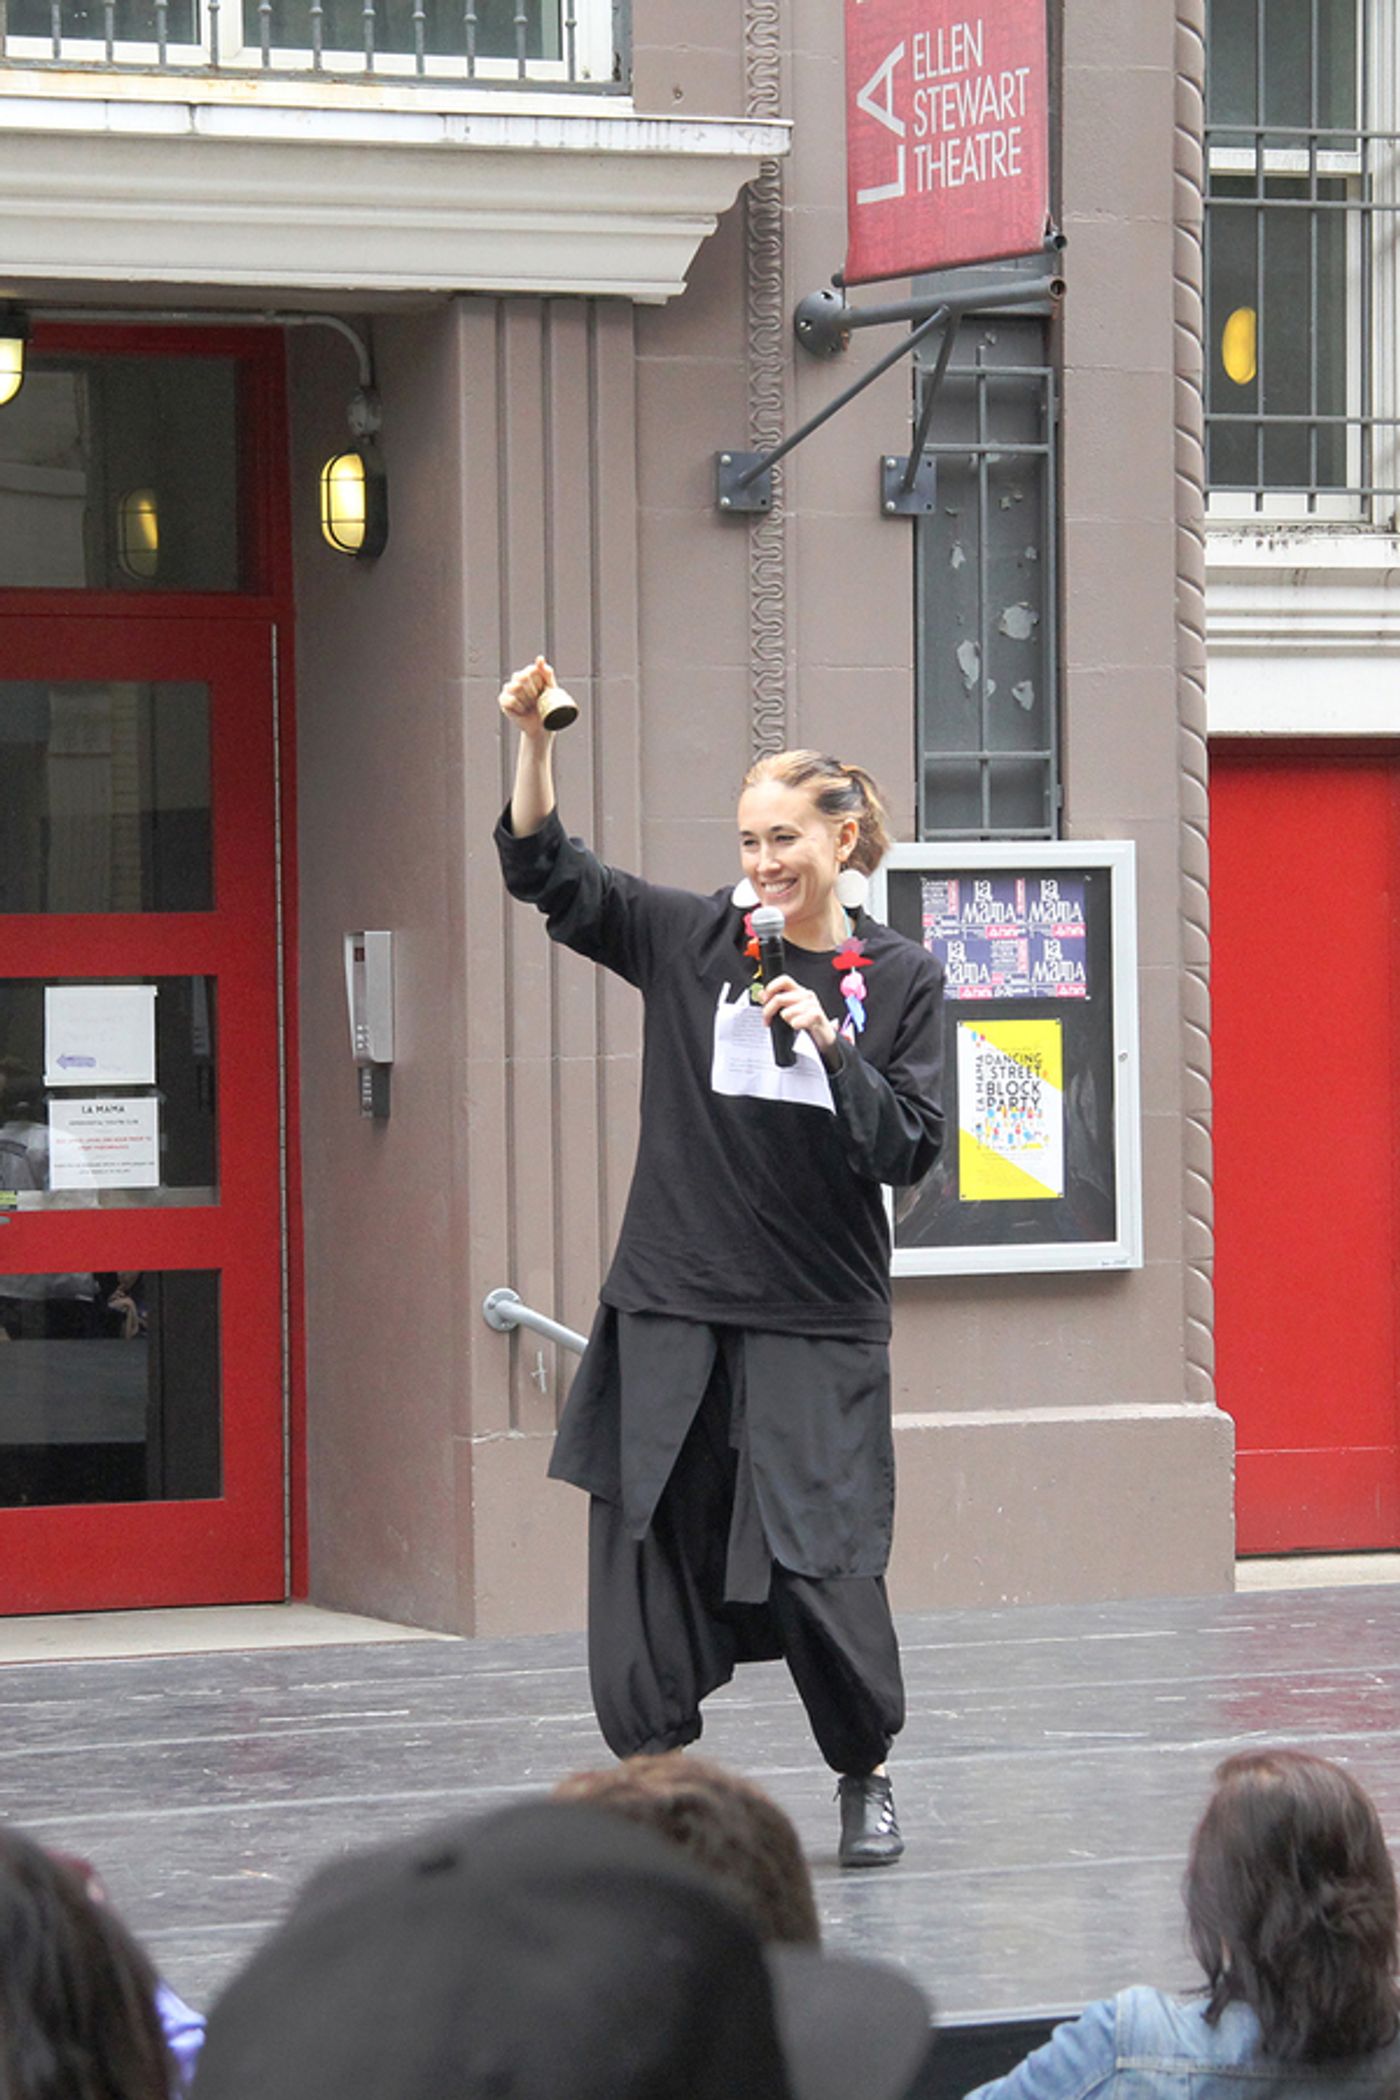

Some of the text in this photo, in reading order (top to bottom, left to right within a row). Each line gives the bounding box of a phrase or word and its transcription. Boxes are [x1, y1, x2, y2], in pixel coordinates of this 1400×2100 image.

[913, 18, 983, 81] ELLEN
[913, 67, 1030, 137] STEWART
[856, 41, 906, 205] LA
[913, 126, 1022, 193] THEATRE
[985, 1052, 1042, 1065] DANCING
[991, 1065, 1042, 1079] STREET
[986, 1080, 1041, 1096] BLOCK
[82, 1105, 125, 1114] LA MAMA
[986, 1096, 1041, 1111] PARTY
